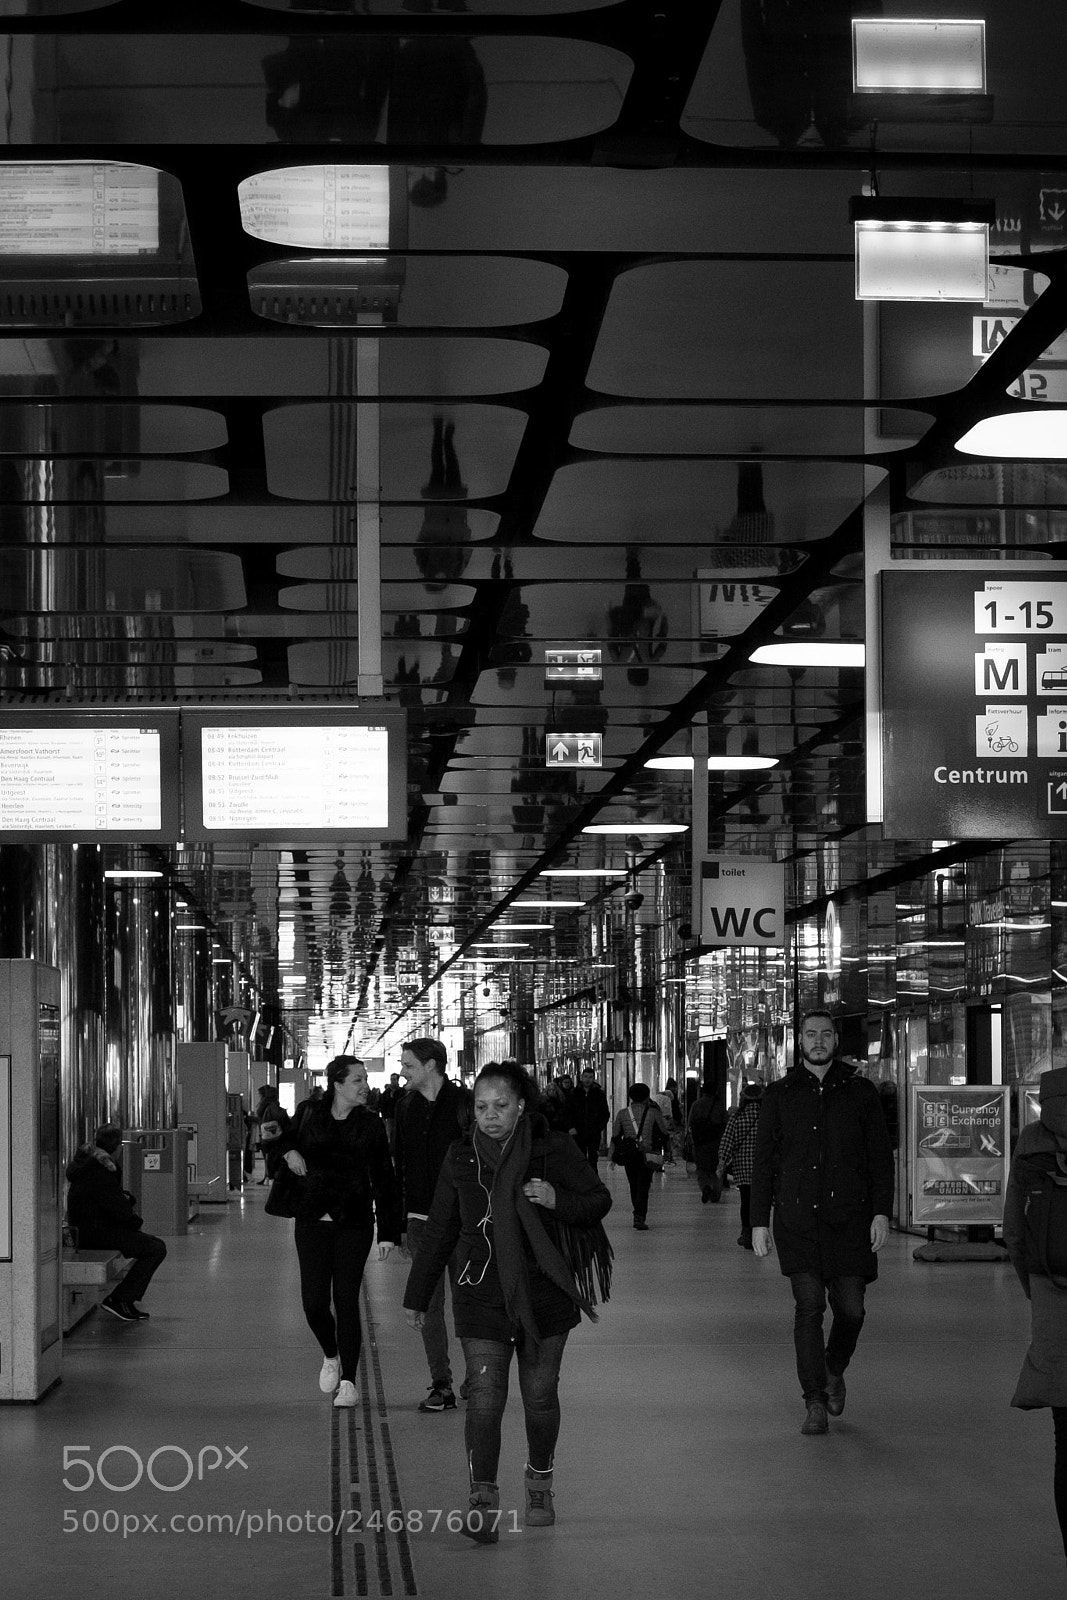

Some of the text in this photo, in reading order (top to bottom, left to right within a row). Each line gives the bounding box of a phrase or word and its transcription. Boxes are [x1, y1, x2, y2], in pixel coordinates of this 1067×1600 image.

[984, 601, 1054, 629] 1-15
[984, 659, 1019, 690] M
[934, 766, 1028, 784] Centrum
[722, 868, 745, 876] toilet
[710, 907, 776, 938] WC
[951, 1104, 1000, 1116] Currency
[951, 1115, 1001, 1127] Exchange
